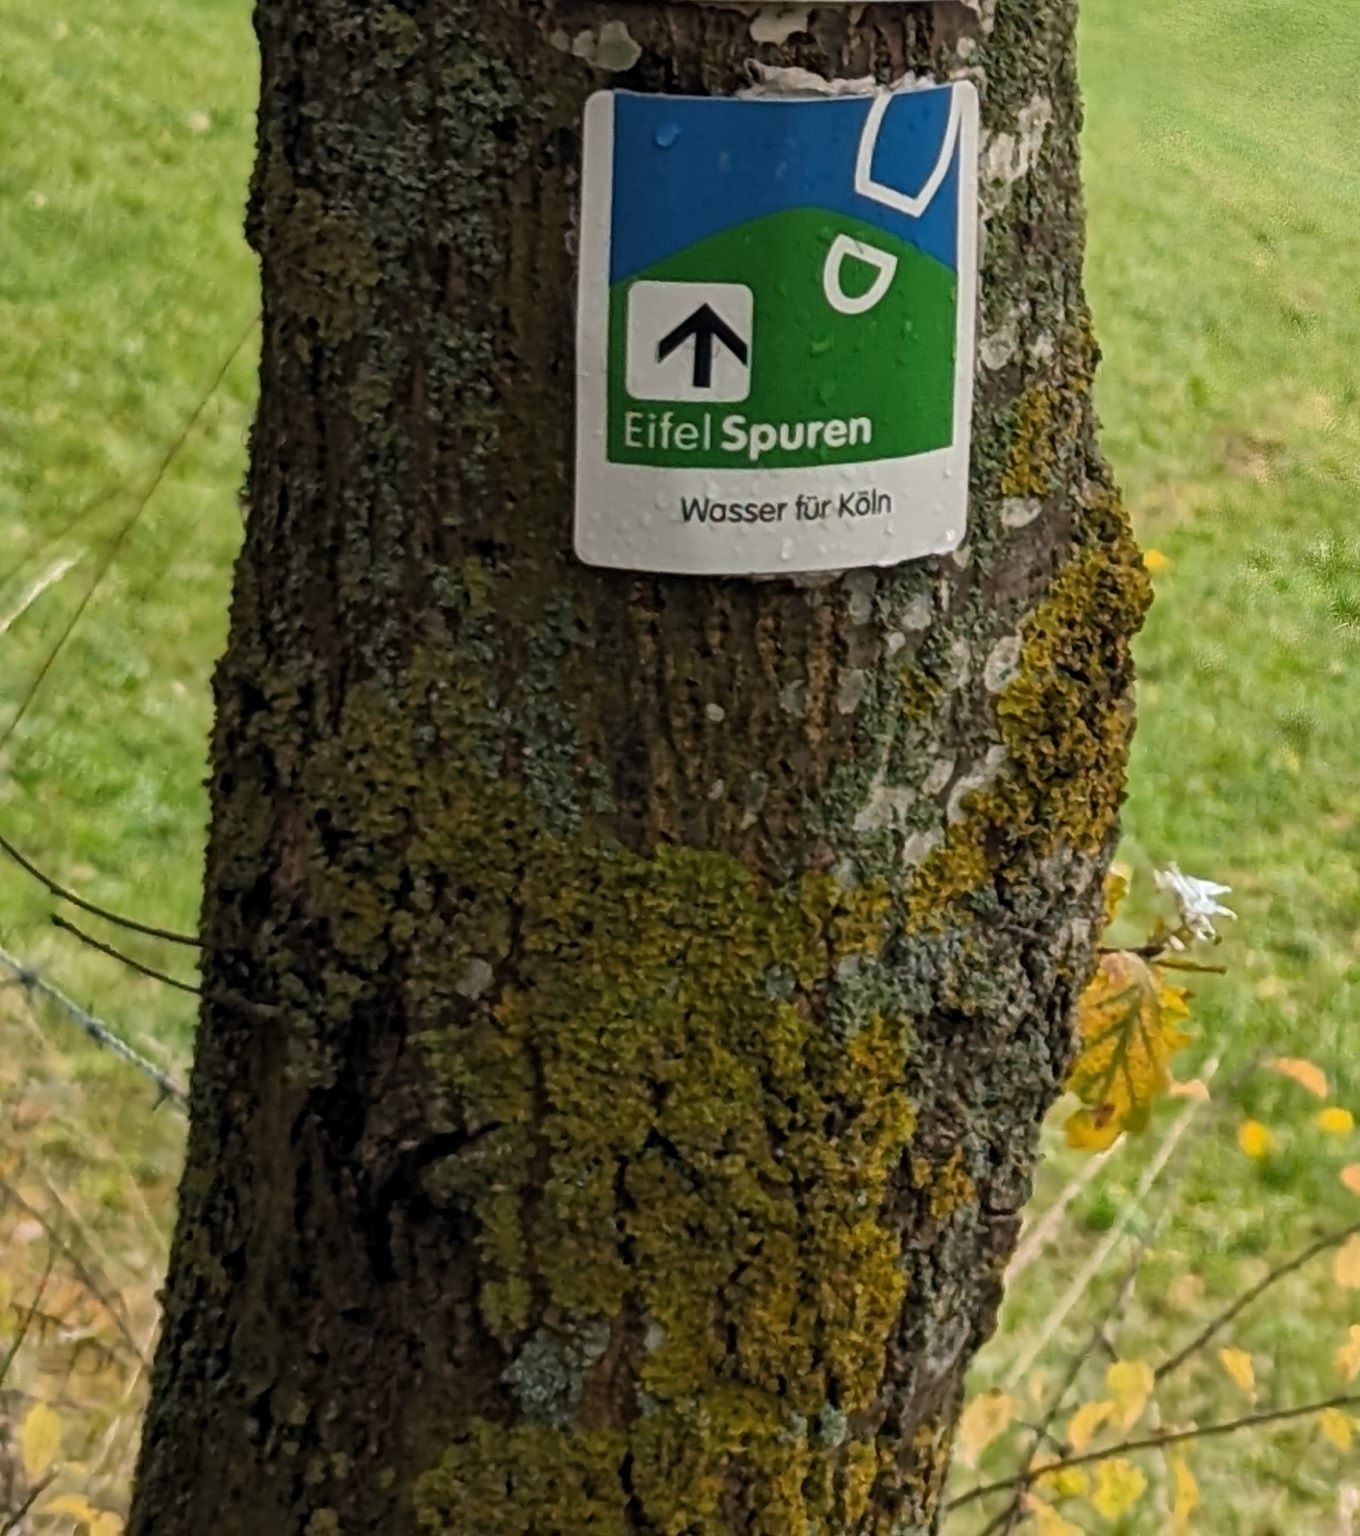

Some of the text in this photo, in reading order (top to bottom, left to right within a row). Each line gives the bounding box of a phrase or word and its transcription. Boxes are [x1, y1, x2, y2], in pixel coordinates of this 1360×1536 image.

[681, 487, 892, 524] Wasser für Köln
